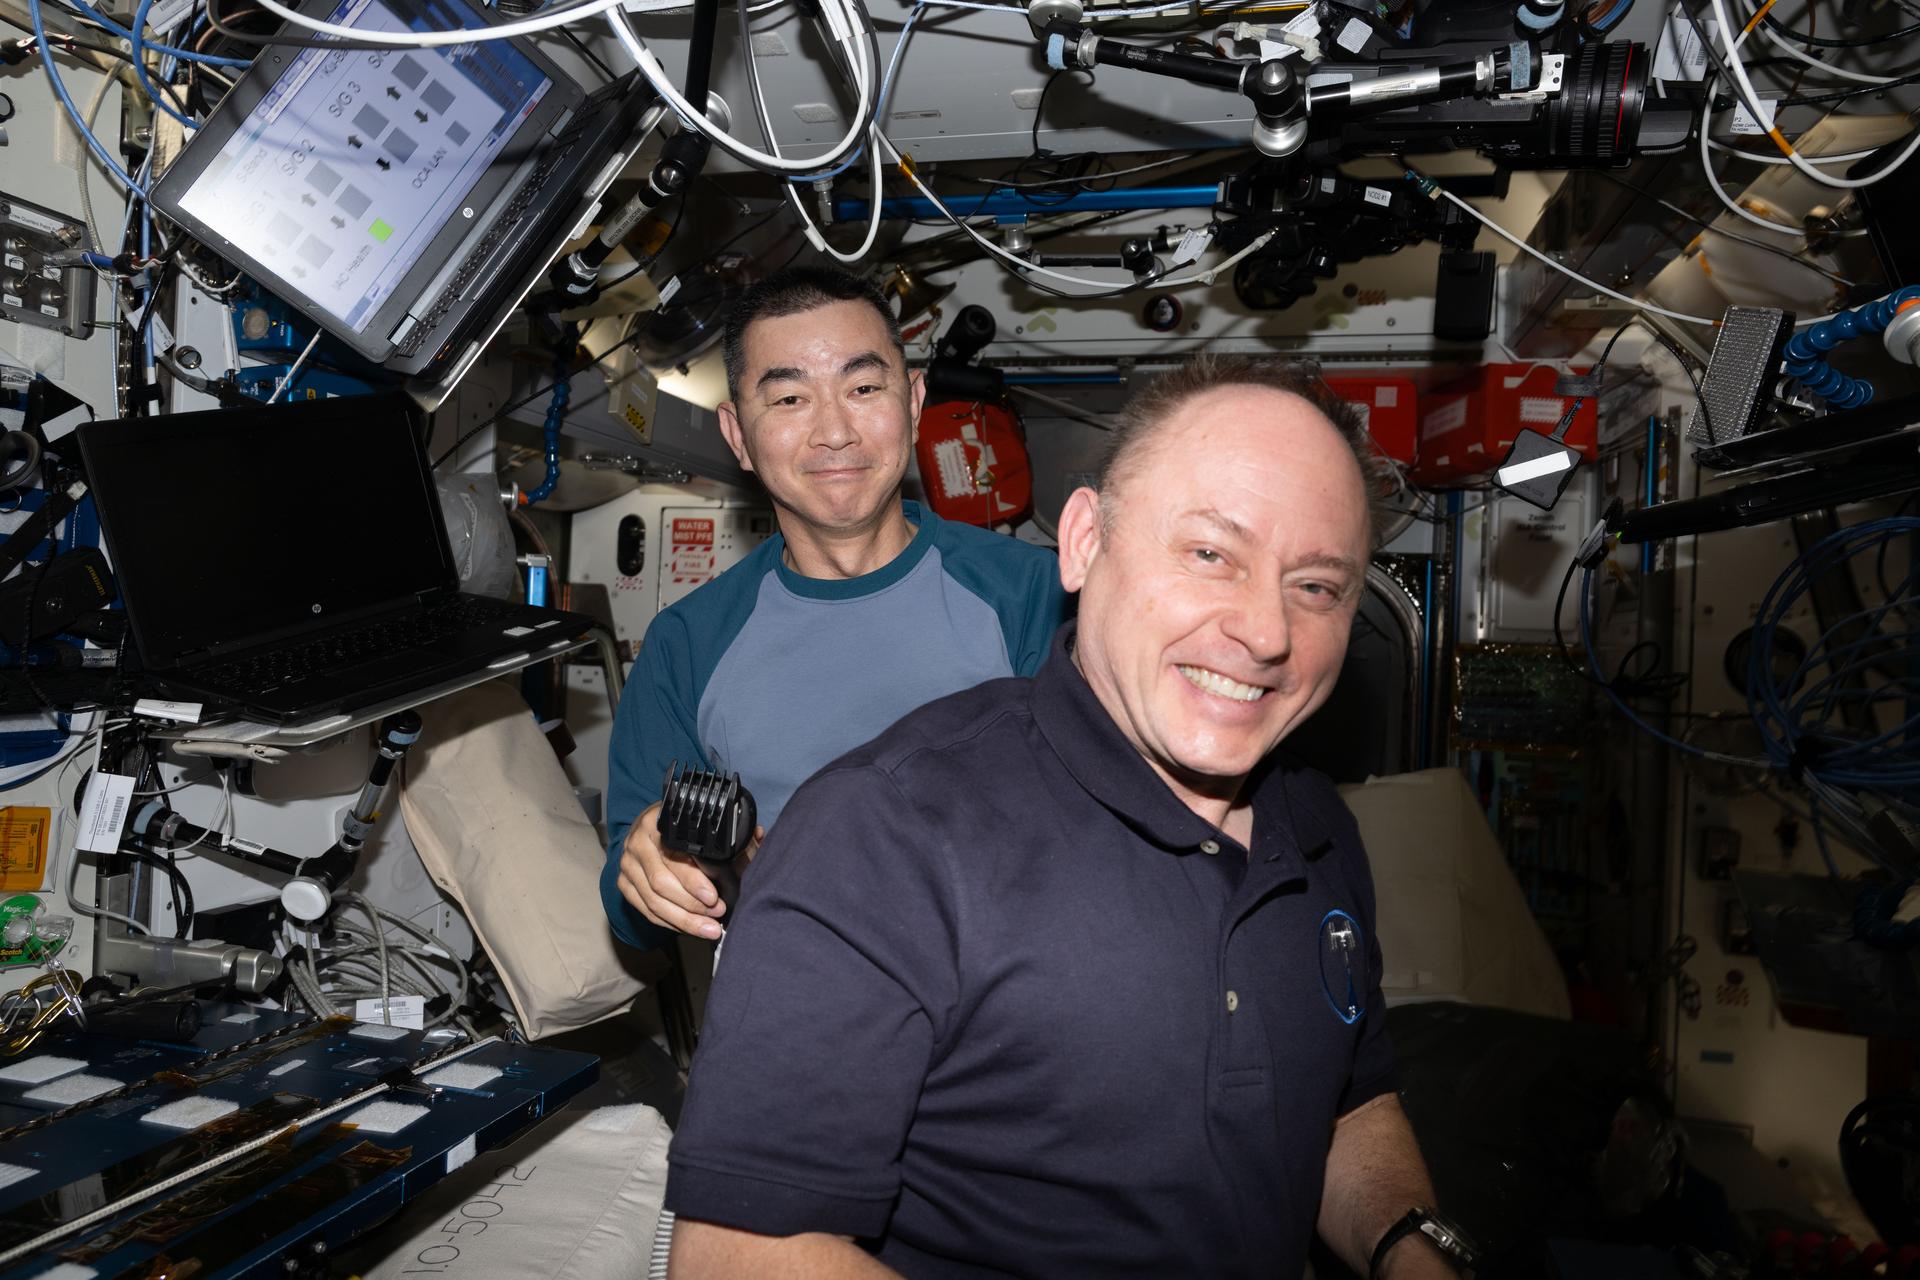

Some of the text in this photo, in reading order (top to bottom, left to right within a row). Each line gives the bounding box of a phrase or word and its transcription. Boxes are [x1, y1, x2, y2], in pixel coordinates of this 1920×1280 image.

[329, 80, 362, 119] S/G 3
[236, 149, 268, 184] S-Band
[281, 139, 315, 177] S/G 2
[430, 147, 447, 168] LAN
[346, 244, 372, 274] Health
[674, 531, 713, 541] MIST PFE
[678, 522, 710, 530] WATER
[3, 905, 23, 913] Magic
